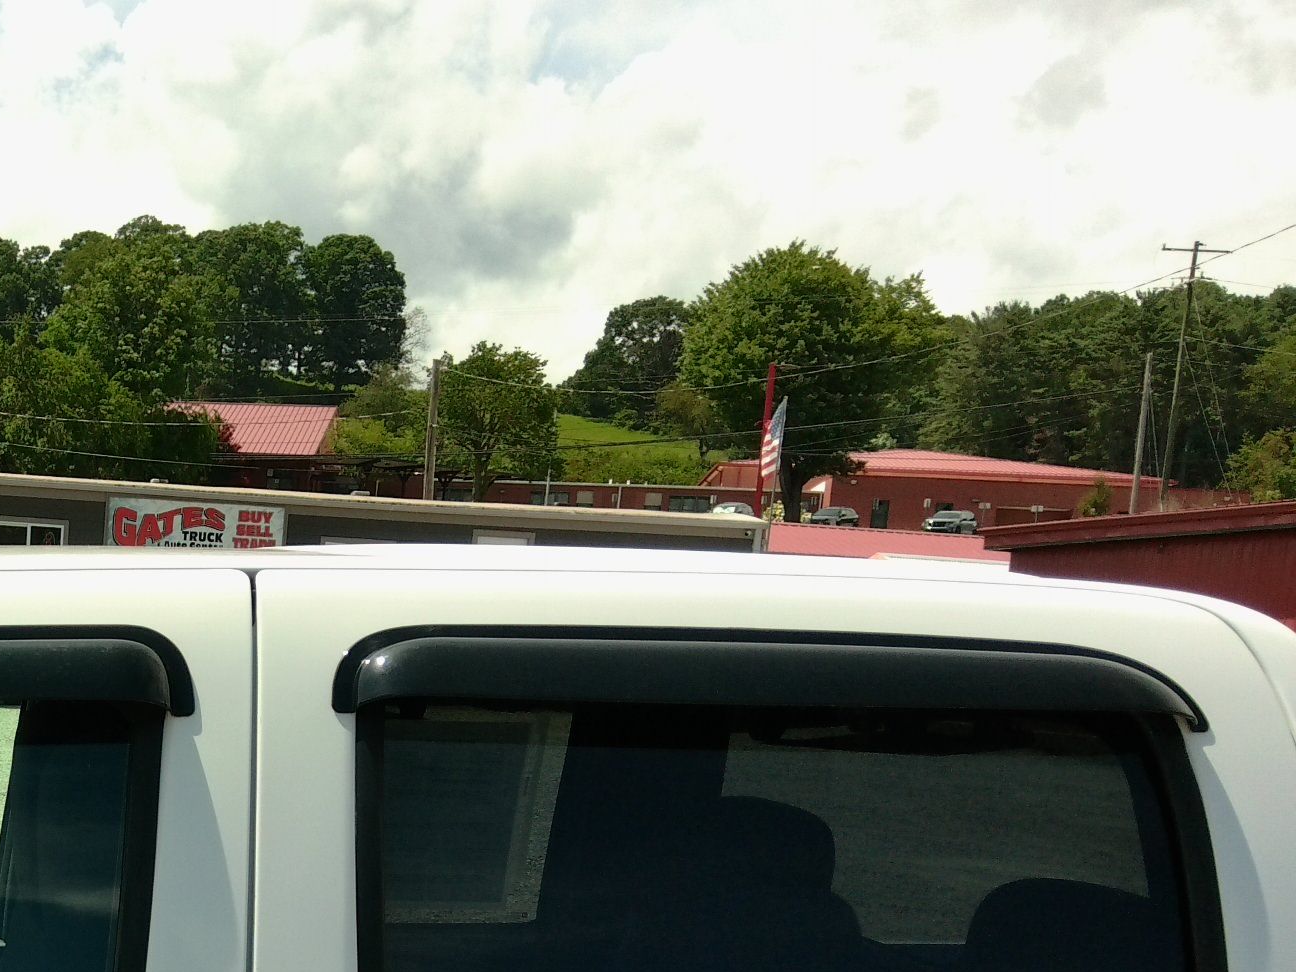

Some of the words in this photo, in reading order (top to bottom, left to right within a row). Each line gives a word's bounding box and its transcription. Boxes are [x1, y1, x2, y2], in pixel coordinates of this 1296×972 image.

[238, 510, 274, 523] BUY
[112, 507, 225, 547] GATES
[236, 524, 273, 537] SELL
[182, 531, 223, 543] TRUCK
